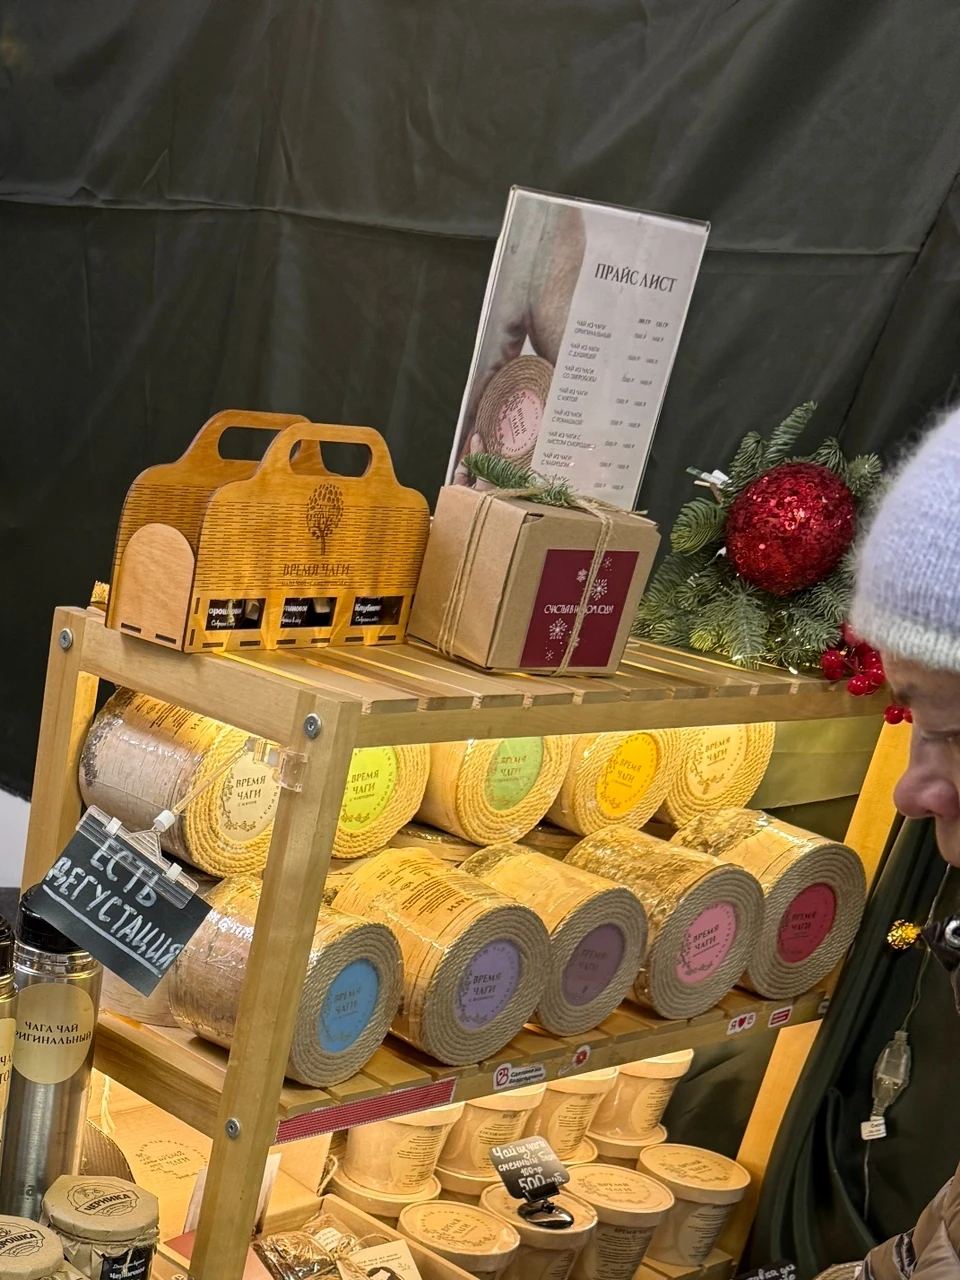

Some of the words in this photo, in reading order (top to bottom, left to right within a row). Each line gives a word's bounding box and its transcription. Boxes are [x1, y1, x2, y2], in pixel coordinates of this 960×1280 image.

[594, 263, 638, 285] ПРАЙС
[639, 275, 677, 293] ЛИСТ
[705, 736, 731, 752] ВРЕМЯ
[236, 776, 266, 788] ВРЕМЯ
[351, 770, 379, 784] ВРЕМЯ
[237, 788, 262, 800] ЧАГИ
[352, 783, 376, 795] ЧАГИ
[89, 837, 158, 908] ЕСТЬ
[45, 856, 184, 969] ДЕГУСТАЦИЯ
[693, 924, 720, 942] ВРЕМЯ
[473, 972, 502, 984] ВРЕМЯ
[473, 985, 496, 996] ЧАГИ
[24, 1020, 54, 1034] ЧАГА
[56, 1021, 79, 1032] ЧАЙ
[84, 1192, 131, 1212] ЧЕРНИКА
